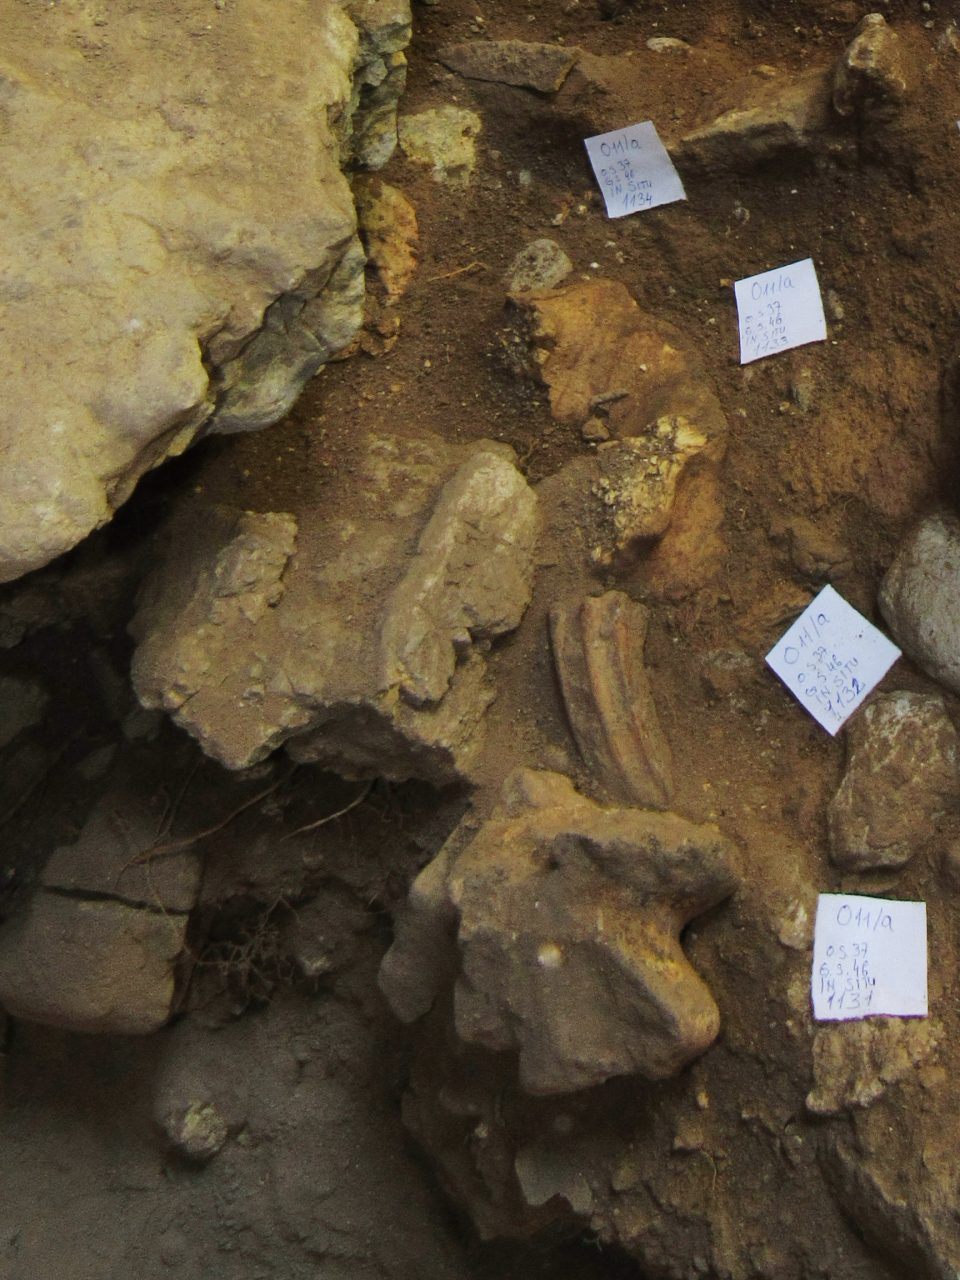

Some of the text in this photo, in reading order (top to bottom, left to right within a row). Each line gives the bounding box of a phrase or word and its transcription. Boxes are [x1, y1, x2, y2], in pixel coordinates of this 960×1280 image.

[833, 657, 859, 687] SITU
[837, 904, 894, 932] O11/a
[821, 977, 876, 994] IN SITU
[828, 990, 873, 1010] 1131
